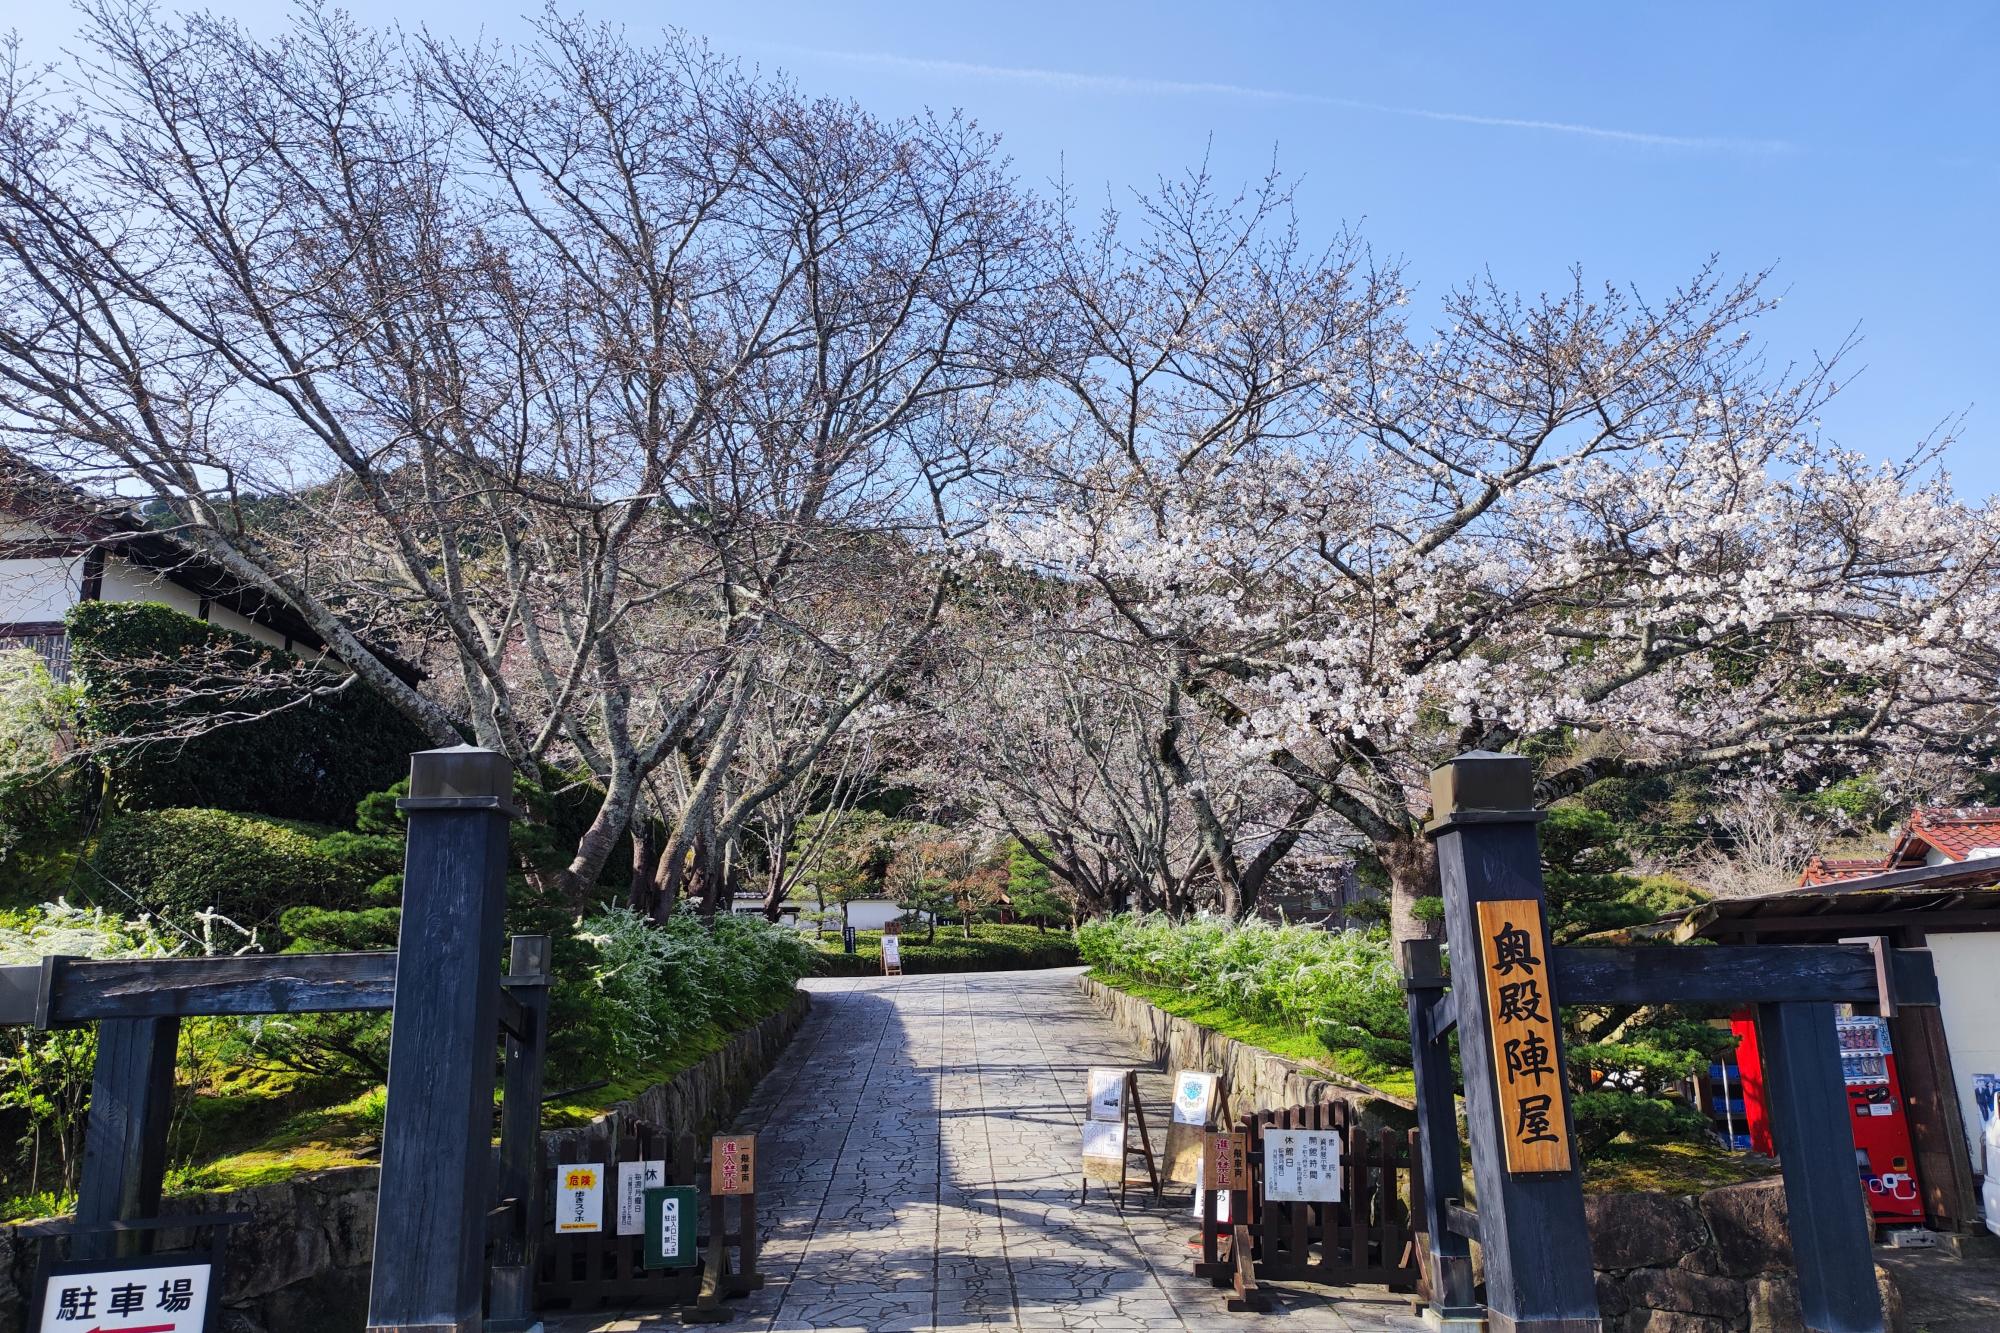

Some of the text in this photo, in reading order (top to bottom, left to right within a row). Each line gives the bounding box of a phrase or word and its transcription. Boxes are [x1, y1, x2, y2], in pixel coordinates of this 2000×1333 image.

[1491, 921, 1560, 1145] 奥殿陣屋
[722, 1141, 738, 1191] 進入禁止
[741, 1146, 750, 1184] 一般車両
[1216, 1138, 1231, 1186] 進入禁止
[1233, 1141, 1243, 1178] 一般車両
[1284, 1136, 1294, 1168] 休館日
[1308, 1136, 1318, 1180] 開館時間
[569, 1175, 591, 1186] 危険
[574, 1190, 585, 1223] 歩きスマホ
[56, 1278, 194, 1321] 駐車場
